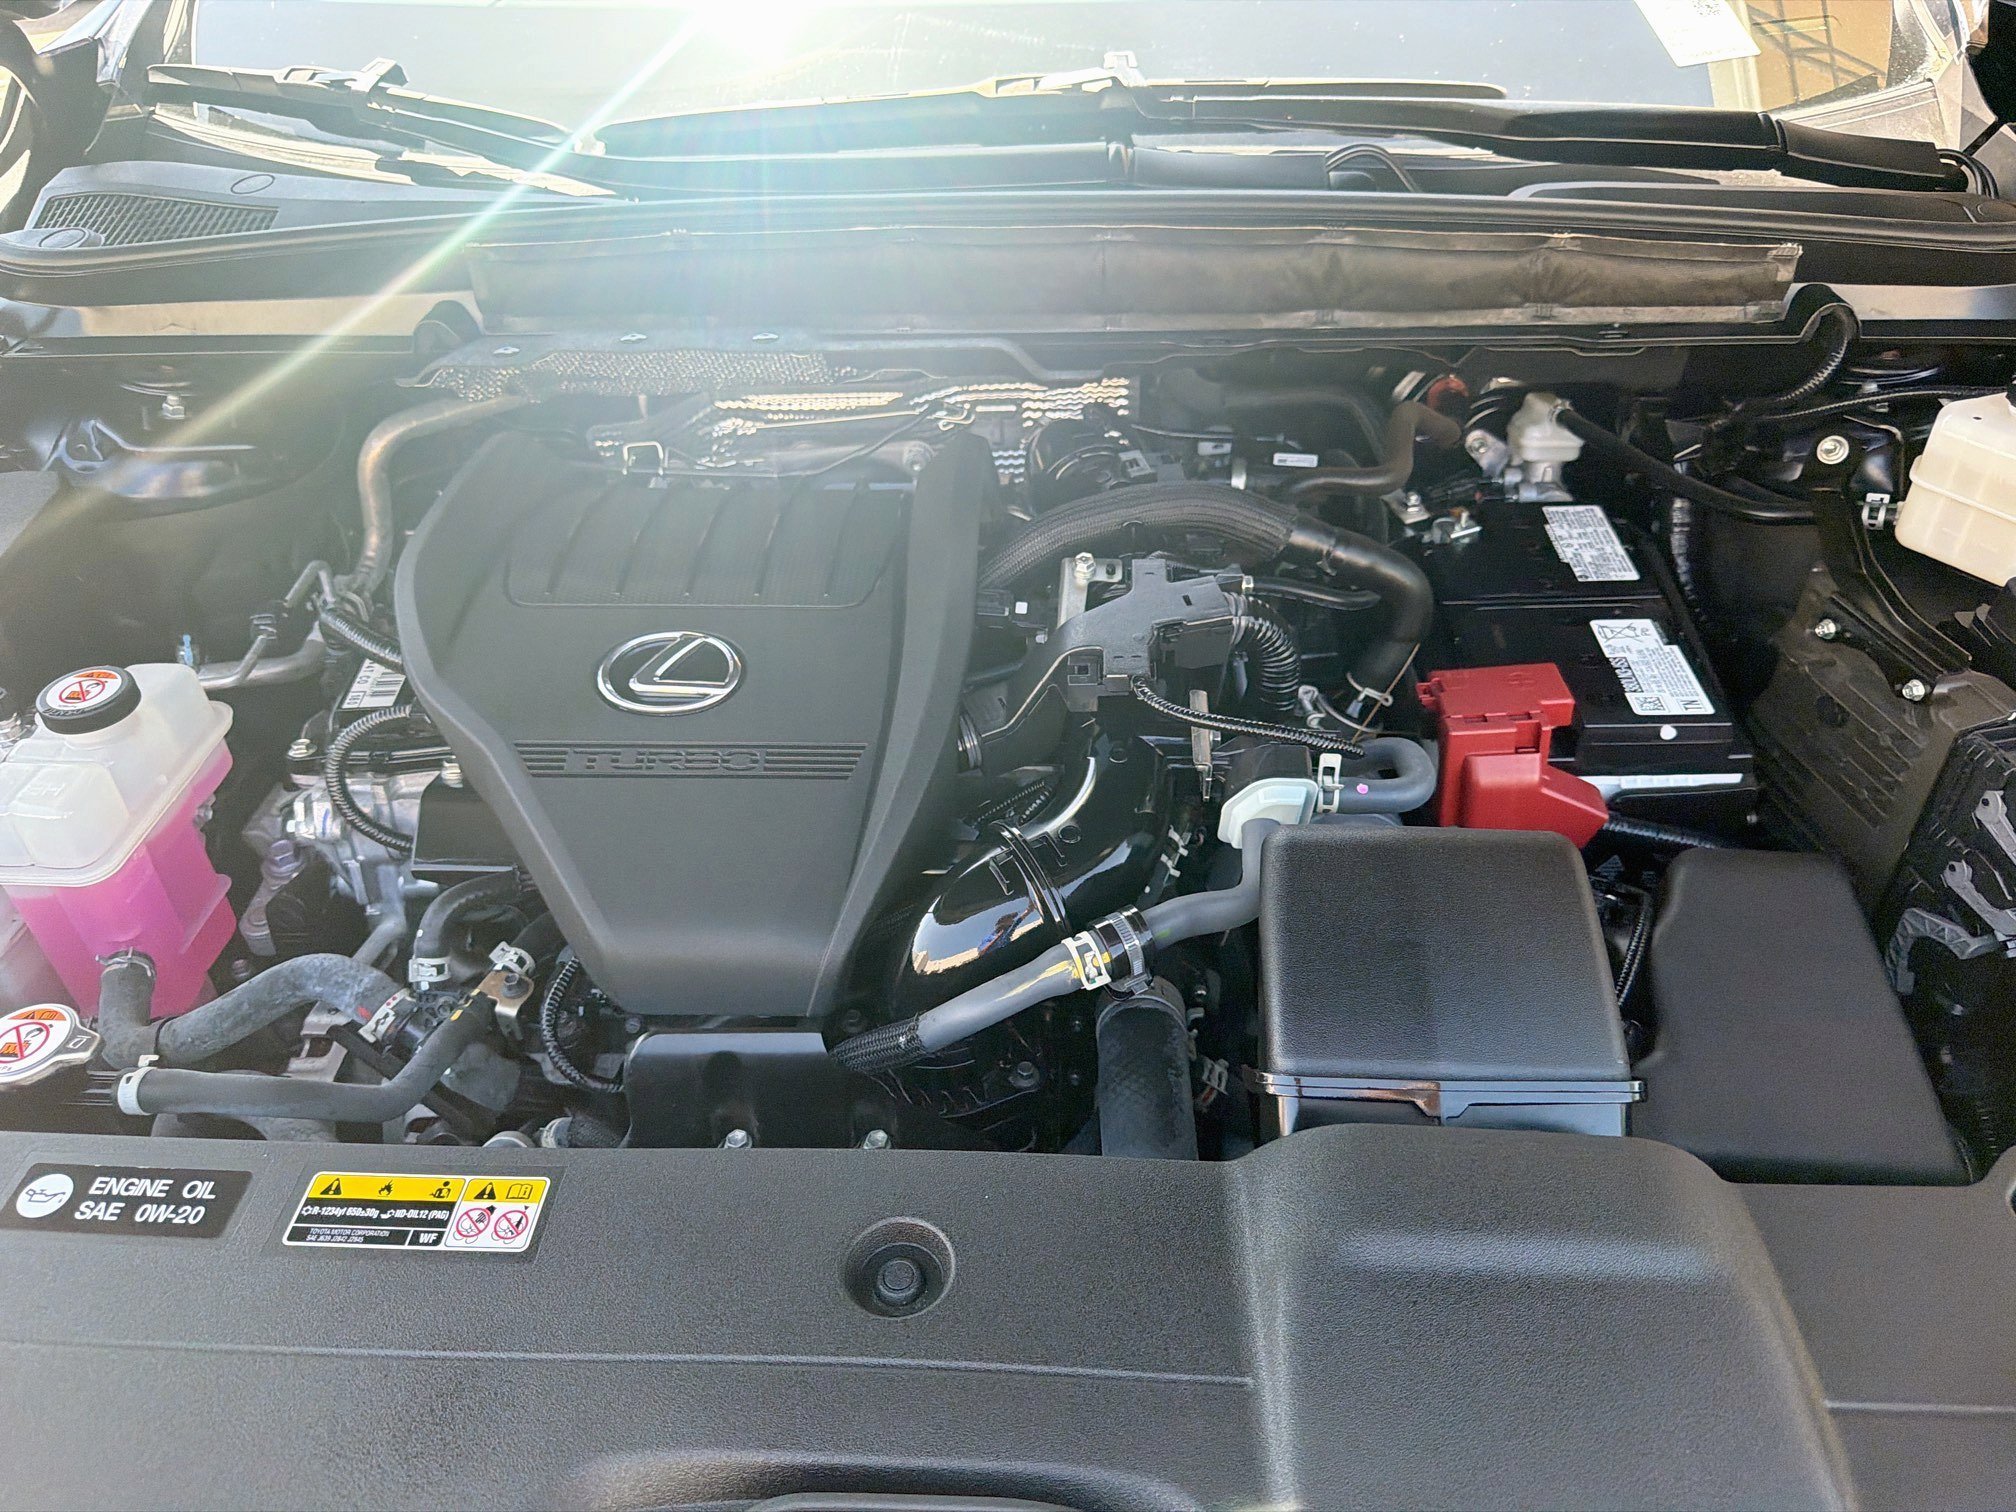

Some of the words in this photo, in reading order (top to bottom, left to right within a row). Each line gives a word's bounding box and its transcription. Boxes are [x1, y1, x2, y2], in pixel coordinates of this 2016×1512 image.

[572, 748, 760, 771] TURBO
[89, 1176, 174, 1198] ENGINE
[182, 1180, 216, 1199] OIL
[75, 1201, 125, 1221] SAE
[134, 1204, 206, 1225] 0W-20
[428, 1210, 450, 1221] (PAG)
[309, 1227, 331, 1235] TOYOTA
[331, 1228, 352, 1236] MOTOR
[351, 1229, 391, 1237] CORPORATION
[419, 1233, 439, 1244] WF
